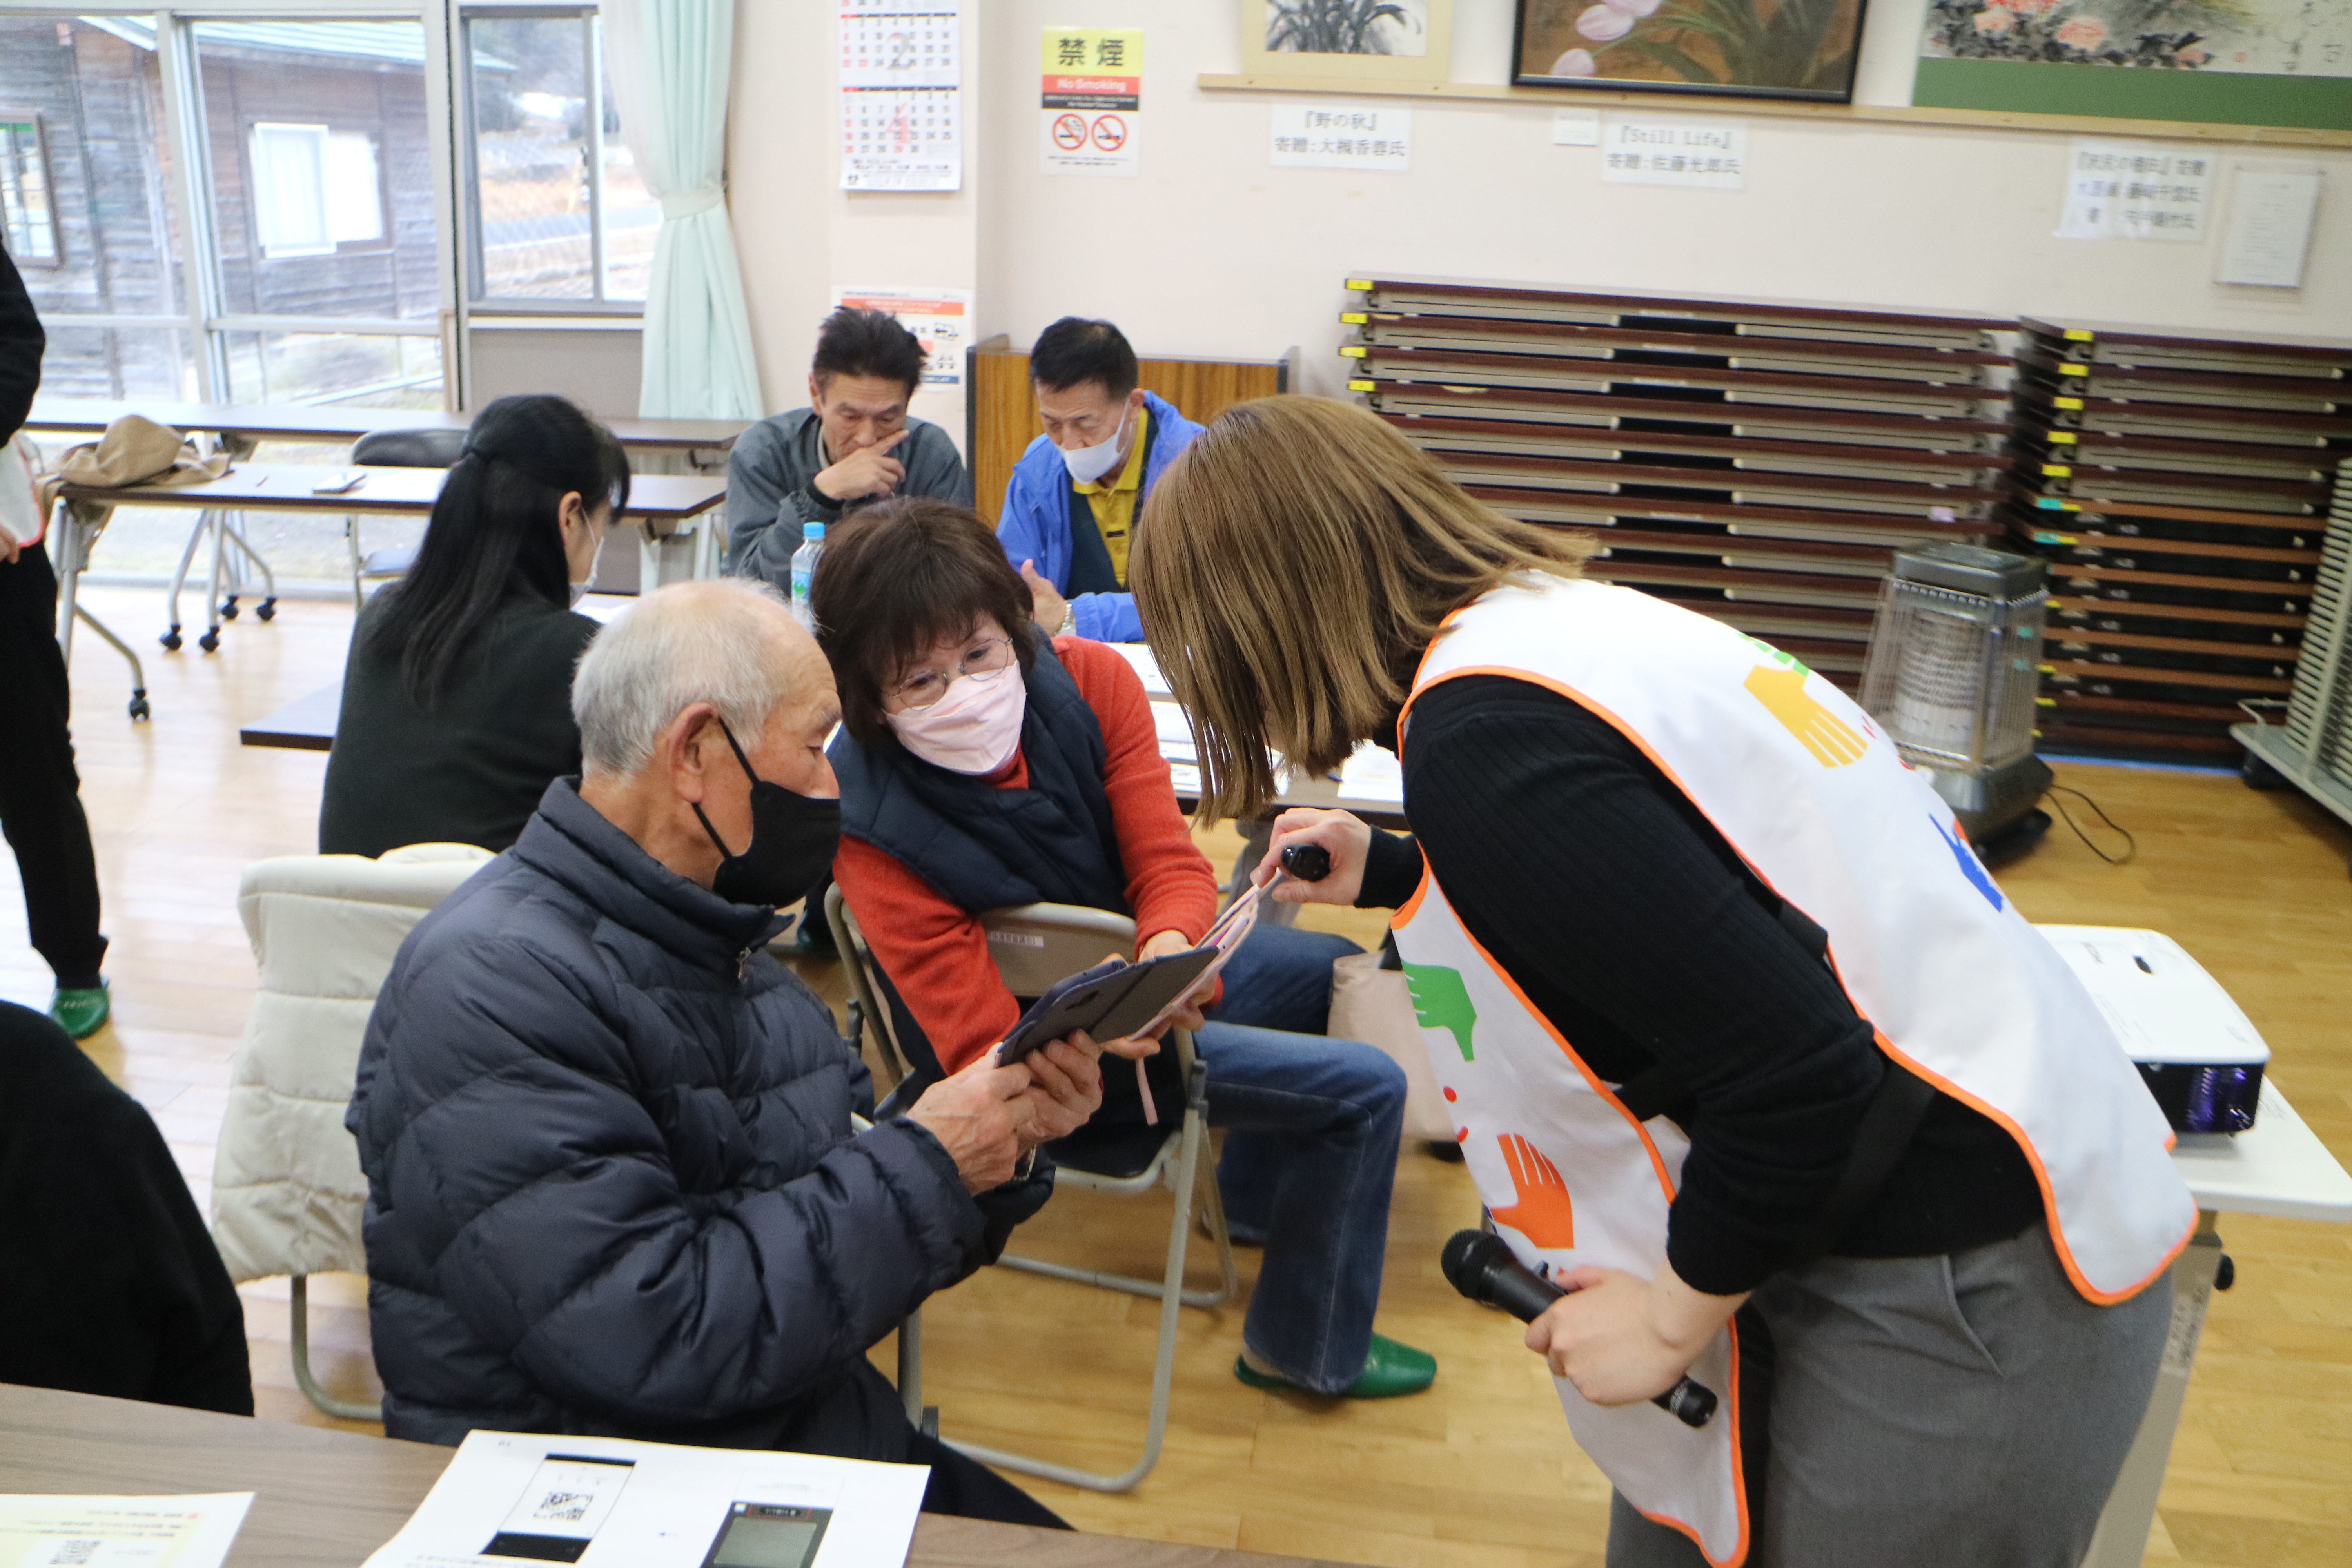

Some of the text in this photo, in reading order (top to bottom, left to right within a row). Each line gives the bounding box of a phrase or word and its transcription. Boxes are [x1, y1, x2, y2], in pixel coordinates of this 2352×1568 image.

[1058, 38, 1124, 66] 禁煙
[1057, 78, 1126, 93] No Smoking
[1305, 110, 1377, 131] 『野の秋』
